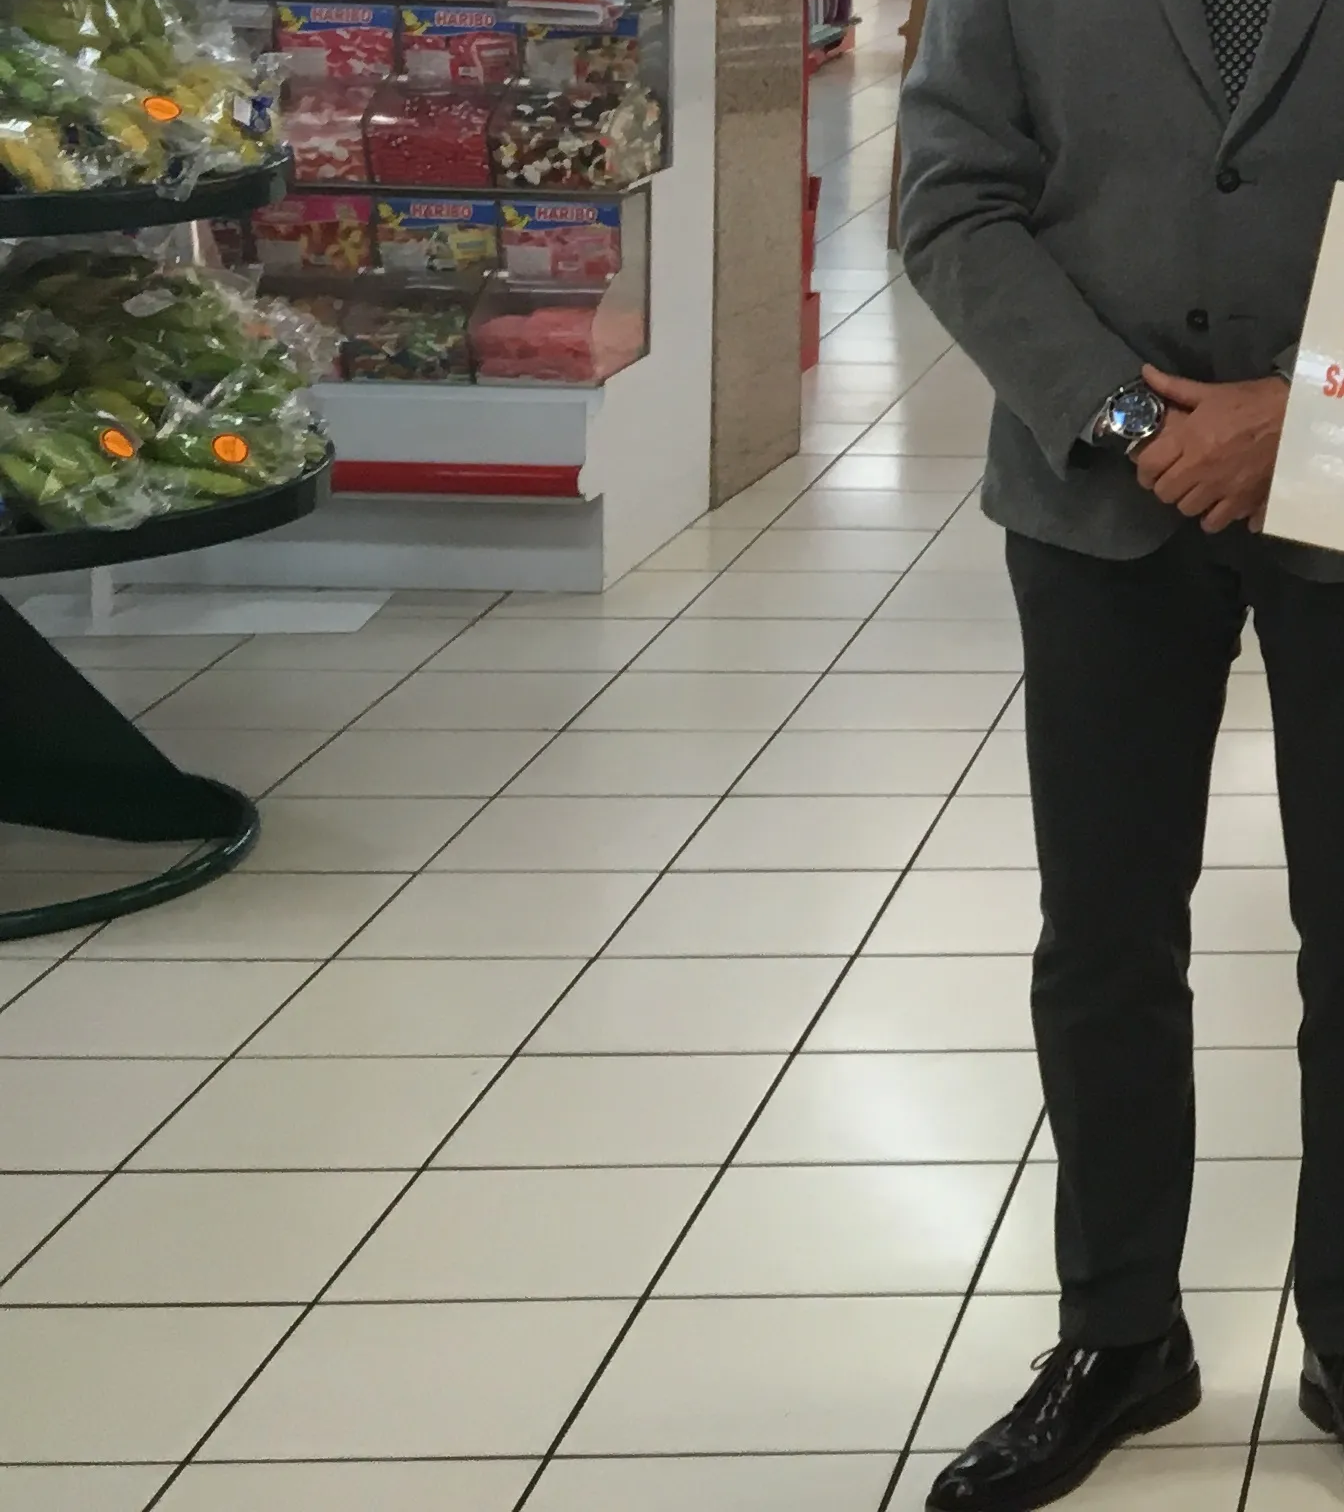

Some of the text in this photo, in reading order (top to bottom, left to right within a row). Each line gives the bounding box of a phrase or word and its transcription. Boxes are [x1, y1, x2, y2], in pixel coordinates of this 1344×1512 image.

[310, 7, 372, 23] HARIBO
[434, 10, 497, 28] HARIBO
[409, 202, 474, 220] HARIBO
[534, 206, 598, 222] HARIBO
